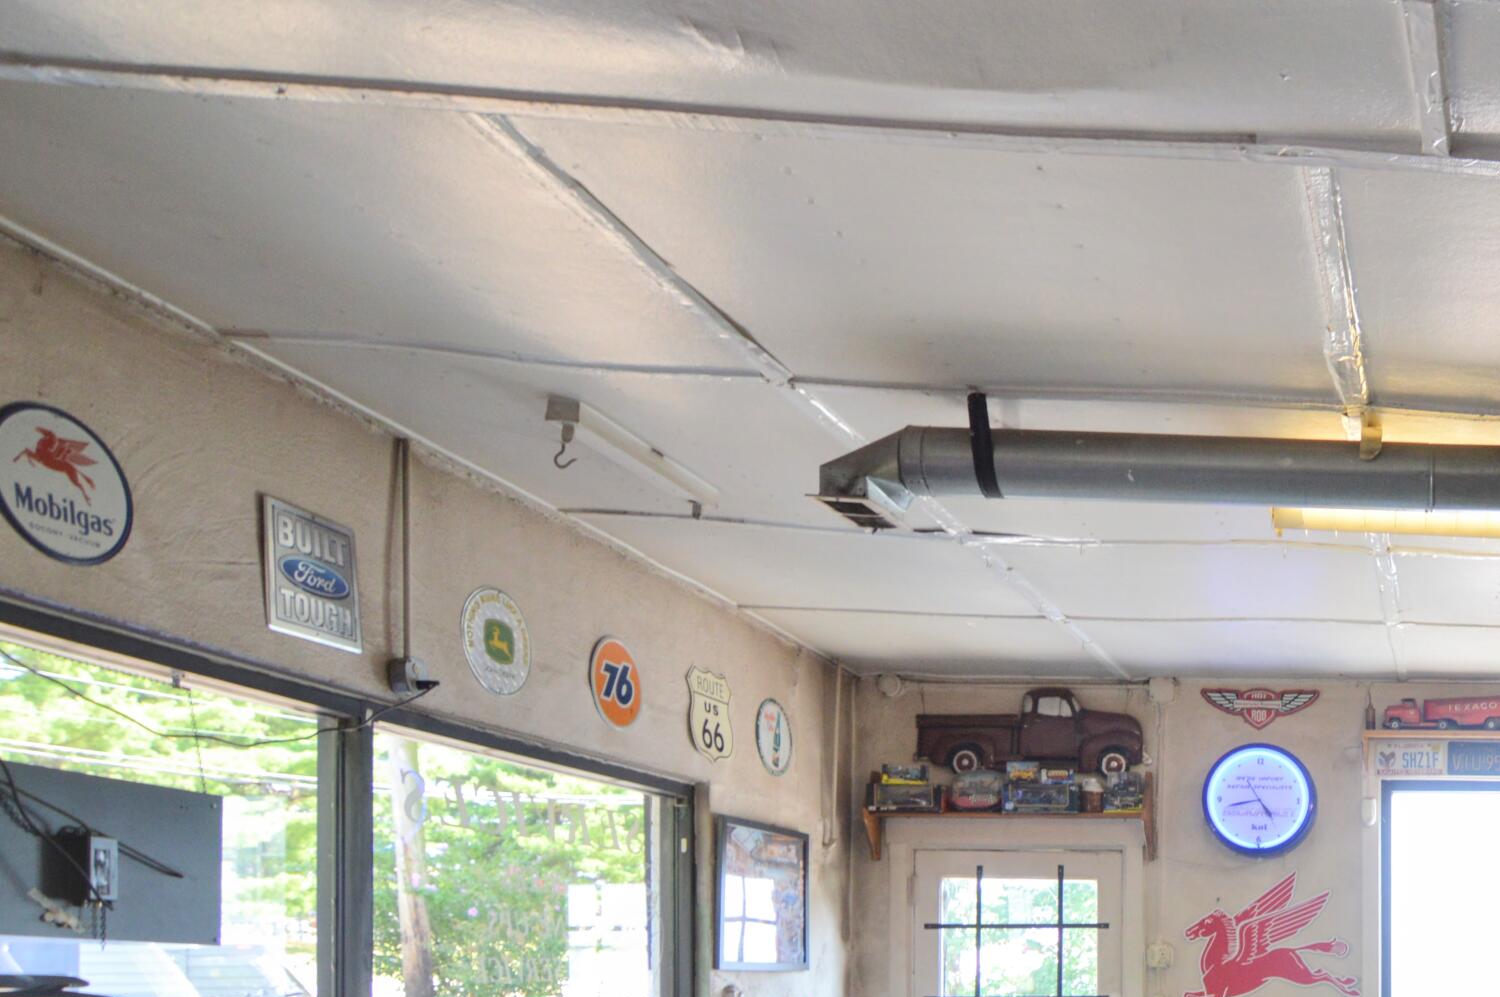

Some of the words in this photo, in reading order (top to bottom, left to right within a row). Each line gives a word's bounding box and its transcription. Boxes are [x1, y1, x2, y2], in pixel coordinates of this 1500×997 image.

[14, 482, 113, 536] Mobilgas
[277, 515, 347, 567] BUILT
[293, 562, 337, 594] Ford
[280, 588, 352, 636] TOUGH
[602, 663, 633, 705] 76
[696, 676, 724, 698] ROUTE
[704, 701, 719, 716] US
[1252, 710, 1267, 722] ROD
[702, 719, 724, 752] 66
